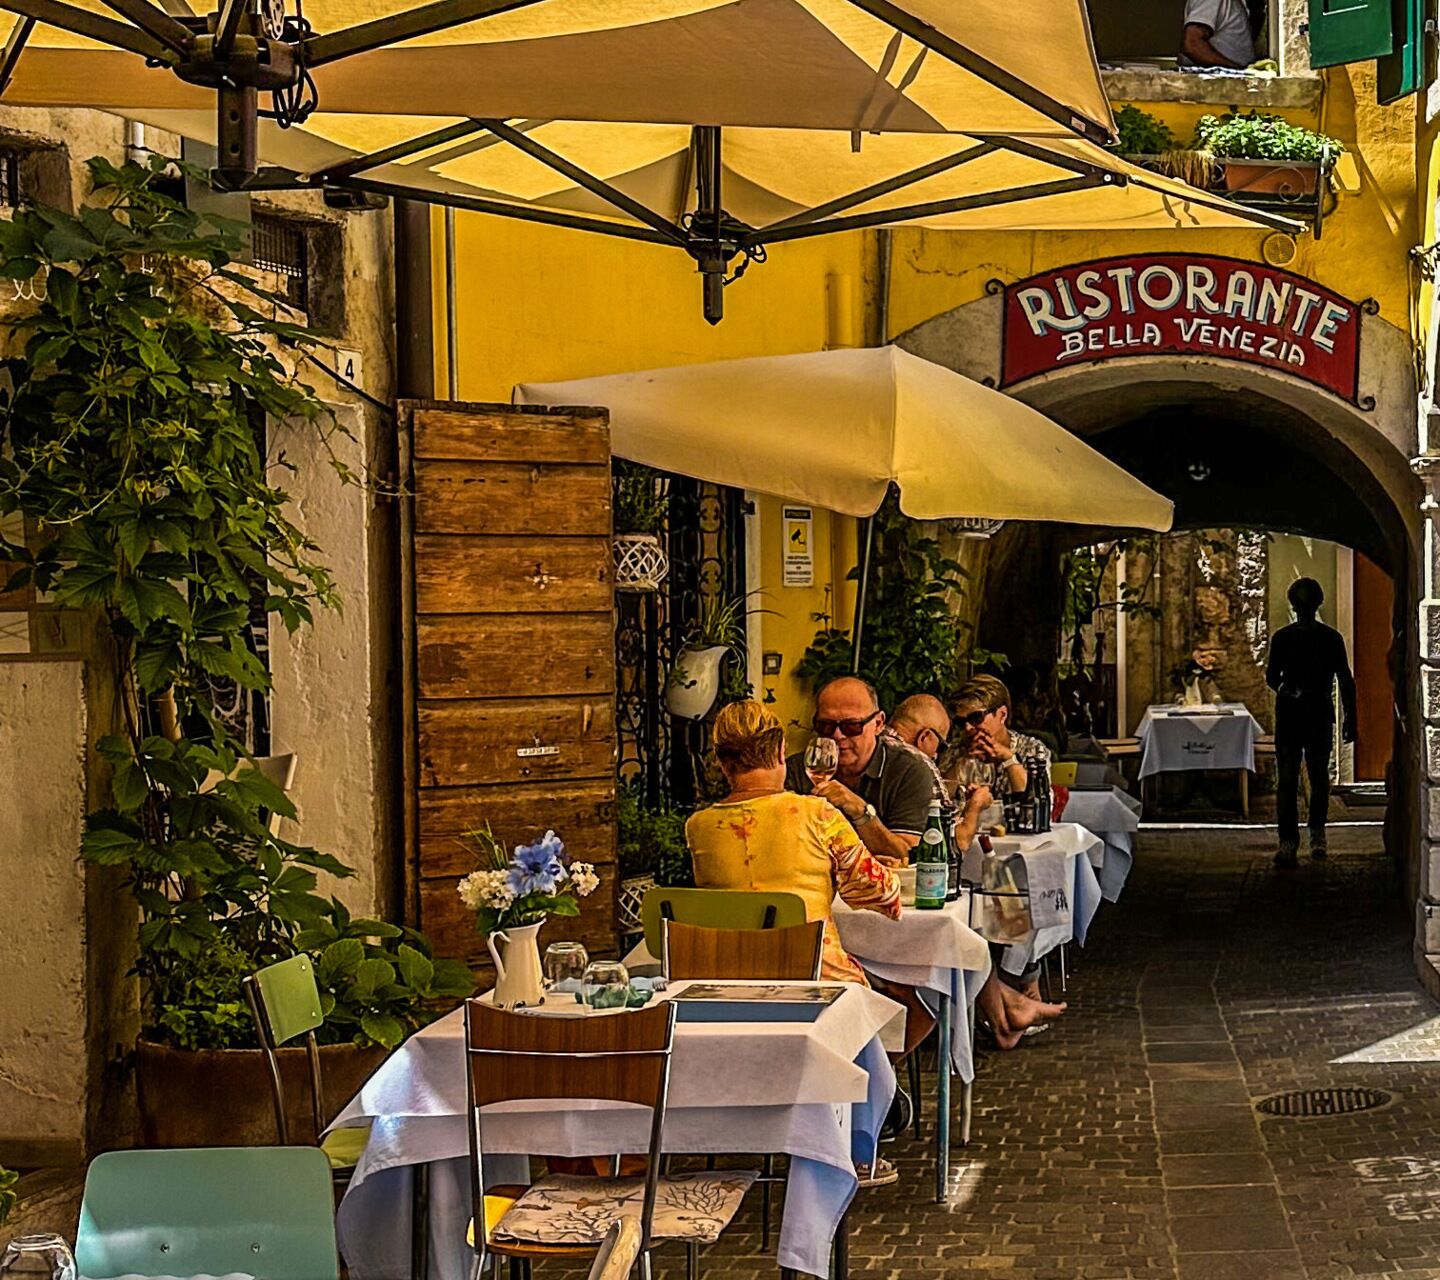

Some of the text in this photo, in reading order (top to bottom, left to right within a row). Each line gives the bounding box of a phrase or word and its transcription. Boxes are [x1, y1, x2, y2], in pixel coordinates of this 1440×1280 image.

[1016, 264, 1349, 354] RISTORANTE
[1056, 317, 1306, 367] BELLA VENEZIA
[345, 358, 355, 381] 4
